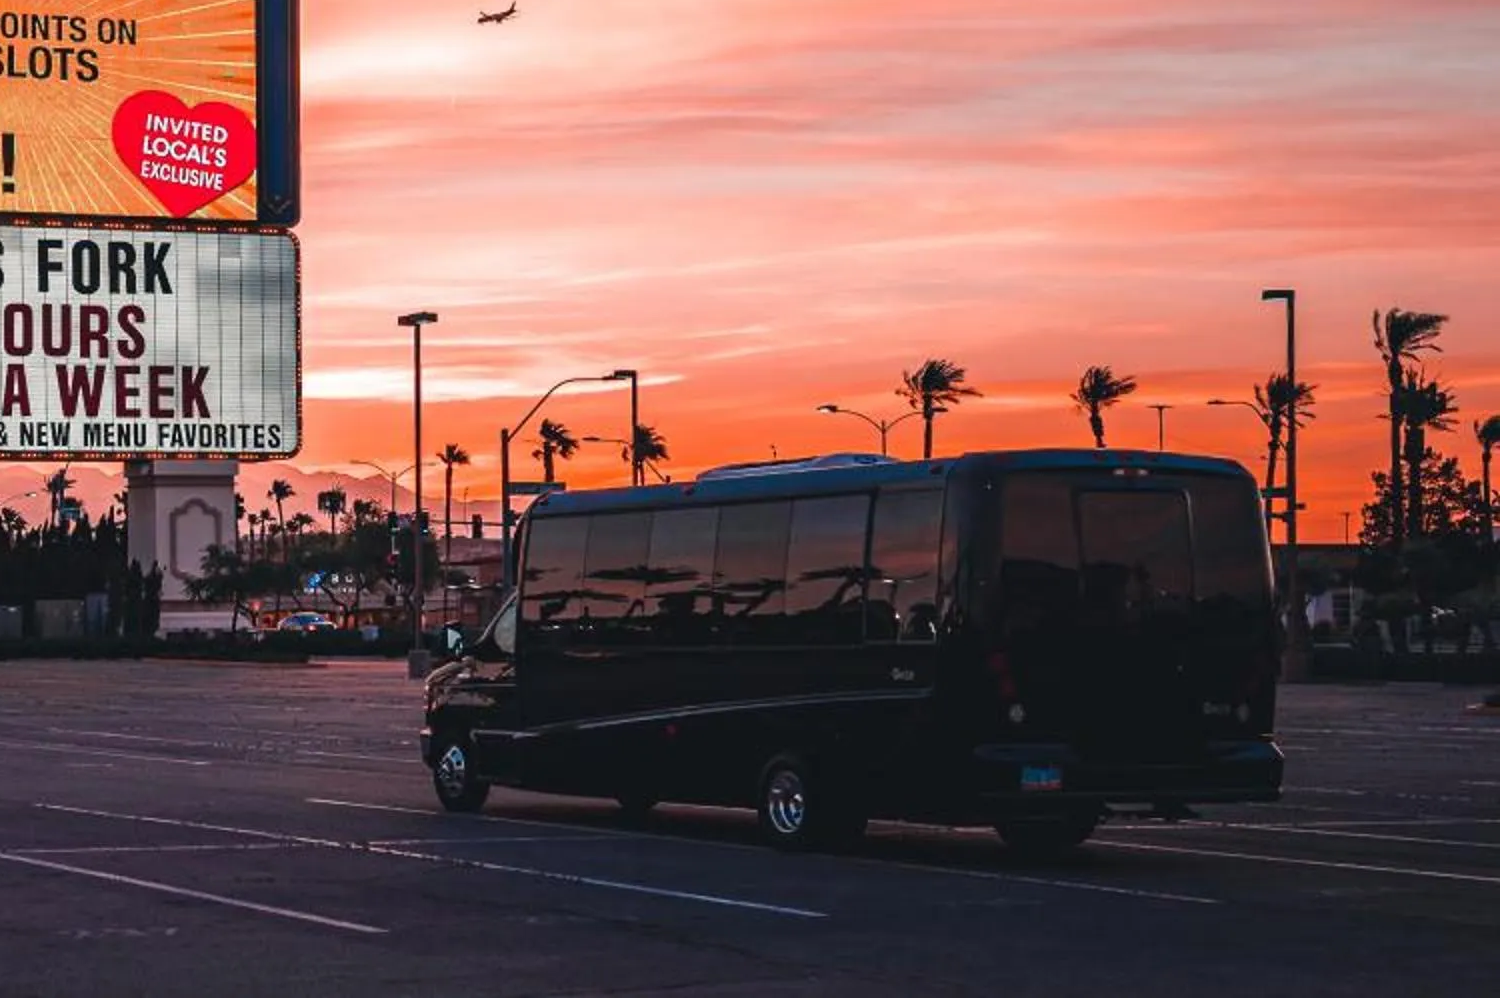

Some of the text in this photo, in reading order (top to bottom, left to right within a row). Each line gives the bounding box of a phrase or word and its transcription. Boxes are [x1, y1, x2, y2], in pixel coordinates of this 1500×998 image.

[97, 17, 137, 45] ON
[146, 113, 228, 143] INVITED
[143, 135, 227, 167] LOCAL'S
[141, 160, 224, 190] EXCLUSIVE
[37, 239, 172, 294] FORK
[2, 363, 33, 416] A
[57, 366, 211, 419] WEEK
[19, 423, 69, 448] NEW
[84, 423, 147, 448] MENU
[158, 424, 282, 449] FAVORITES
